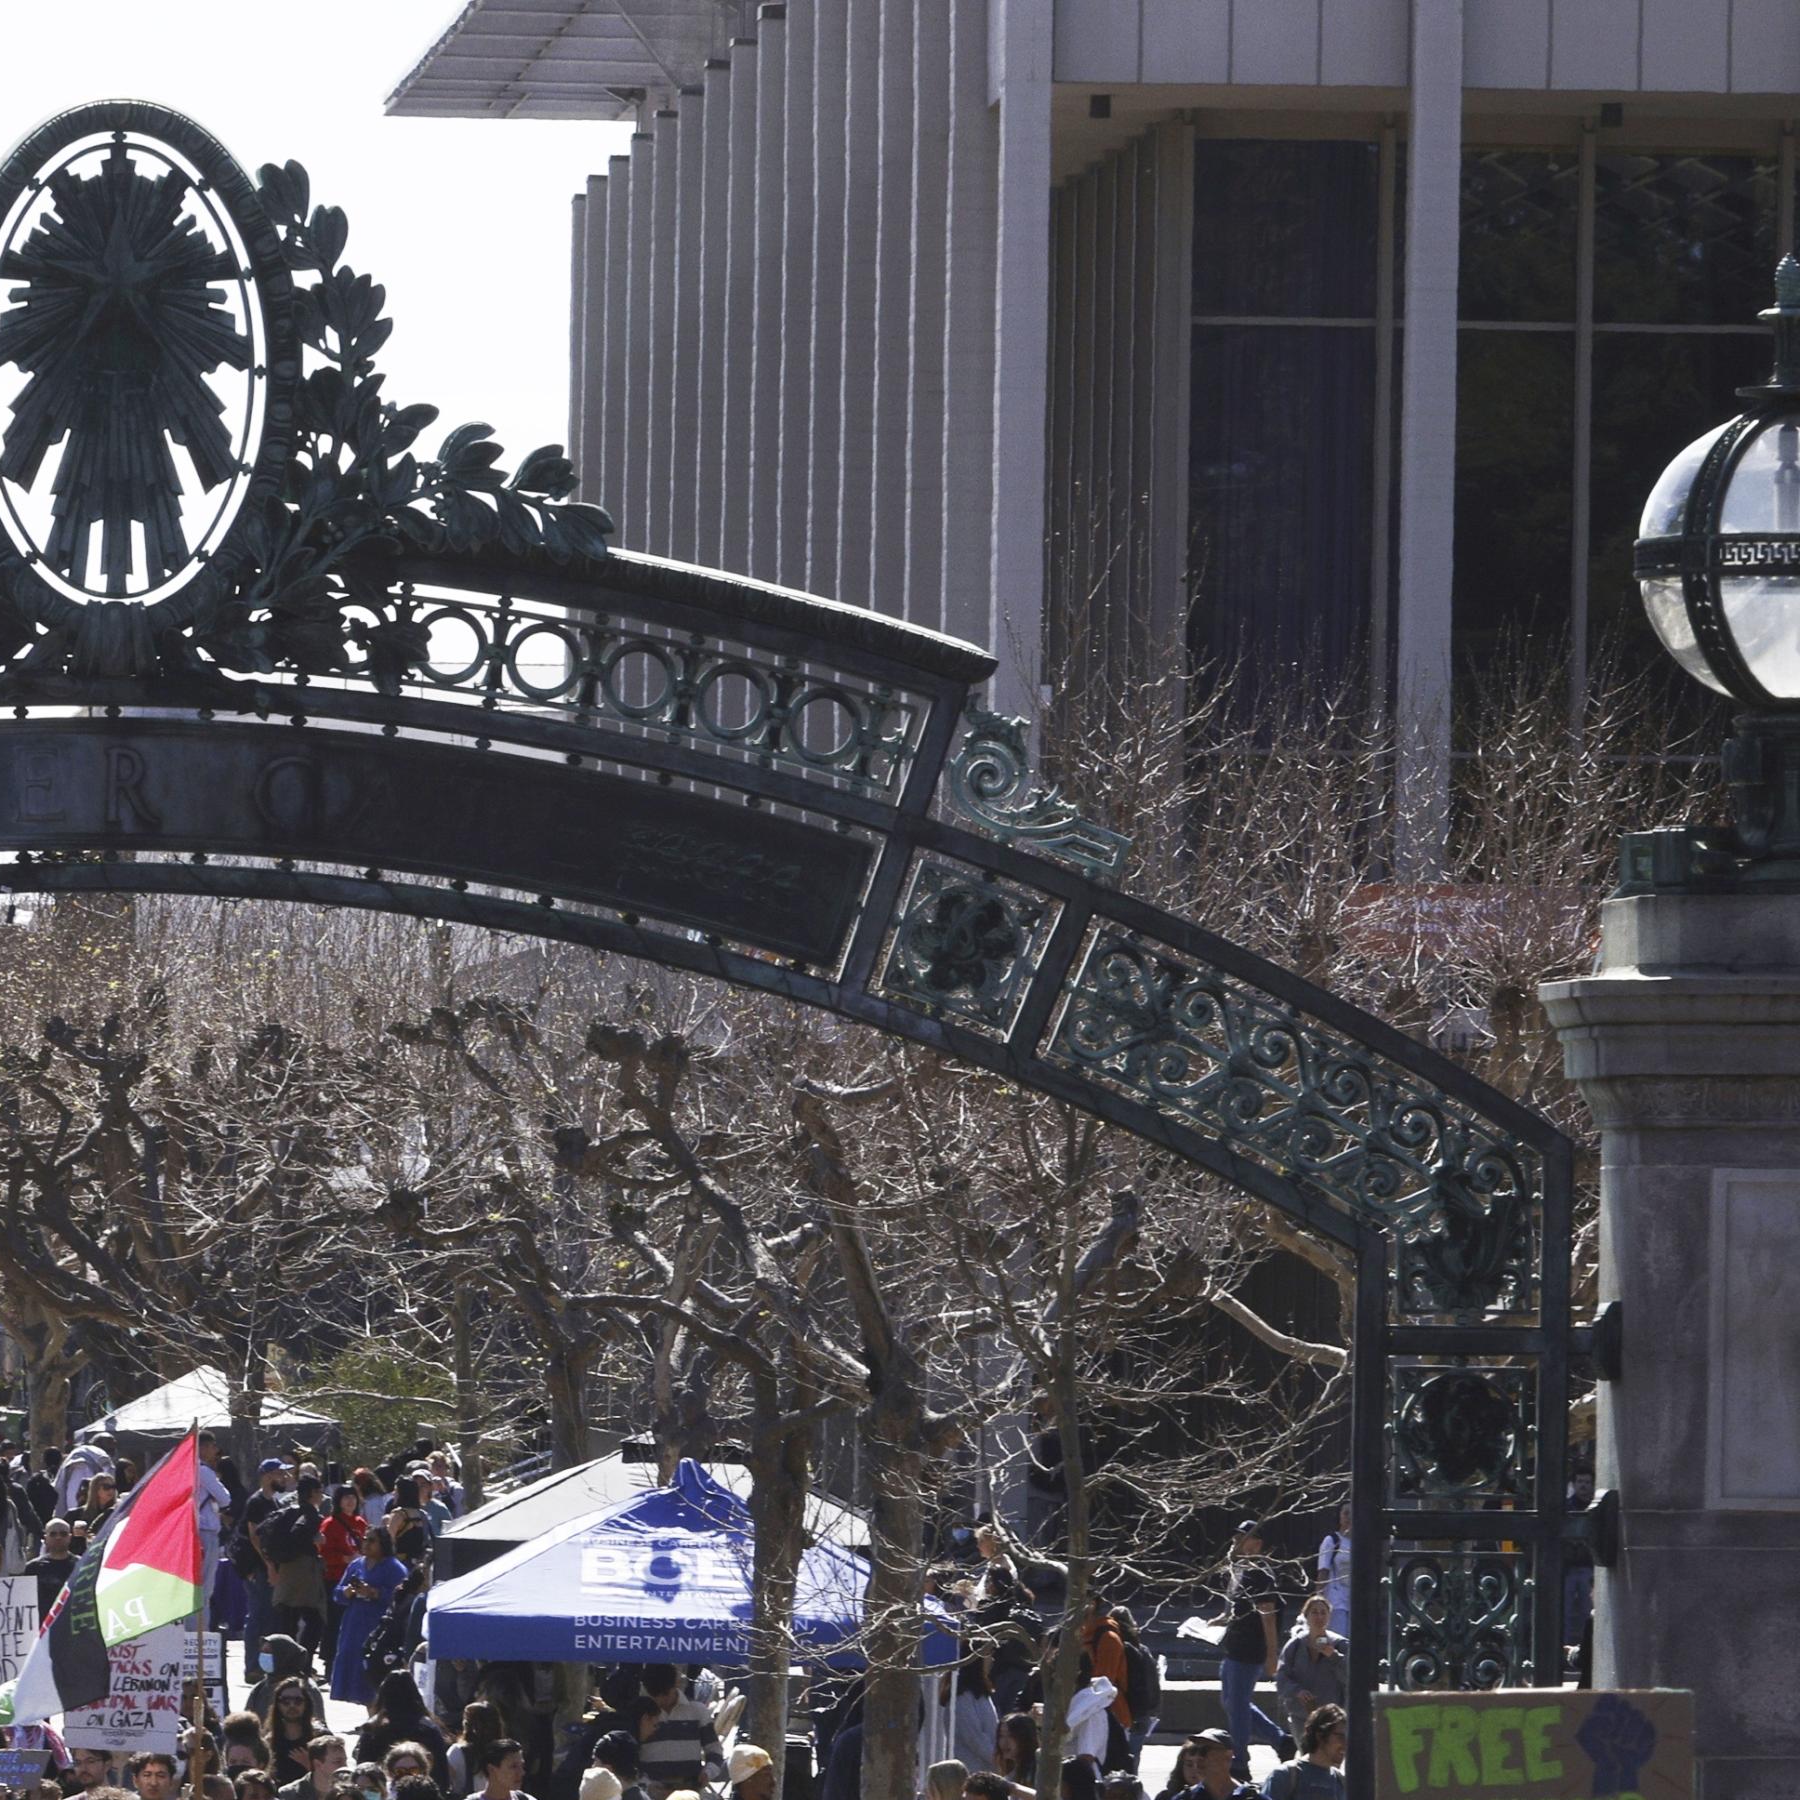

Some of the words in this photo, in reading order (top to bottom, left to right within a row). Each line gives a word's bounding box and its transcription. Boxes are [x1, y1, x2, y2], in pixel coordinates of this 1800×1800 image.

[581, 1548, 752, 1587] BCE
[574, 1616, 676, 1630] BUSINESS
[160, 1661, 180, 1677] ON
[113, 1676, 170, 1693] LEBANON
[147, 1695, 179, 1714] WAR
[87, 1714, 105, 1726] ON
[110, 1710, 155, 1730] GAZA
[1384, 1705, 1563, 1793] FREE
